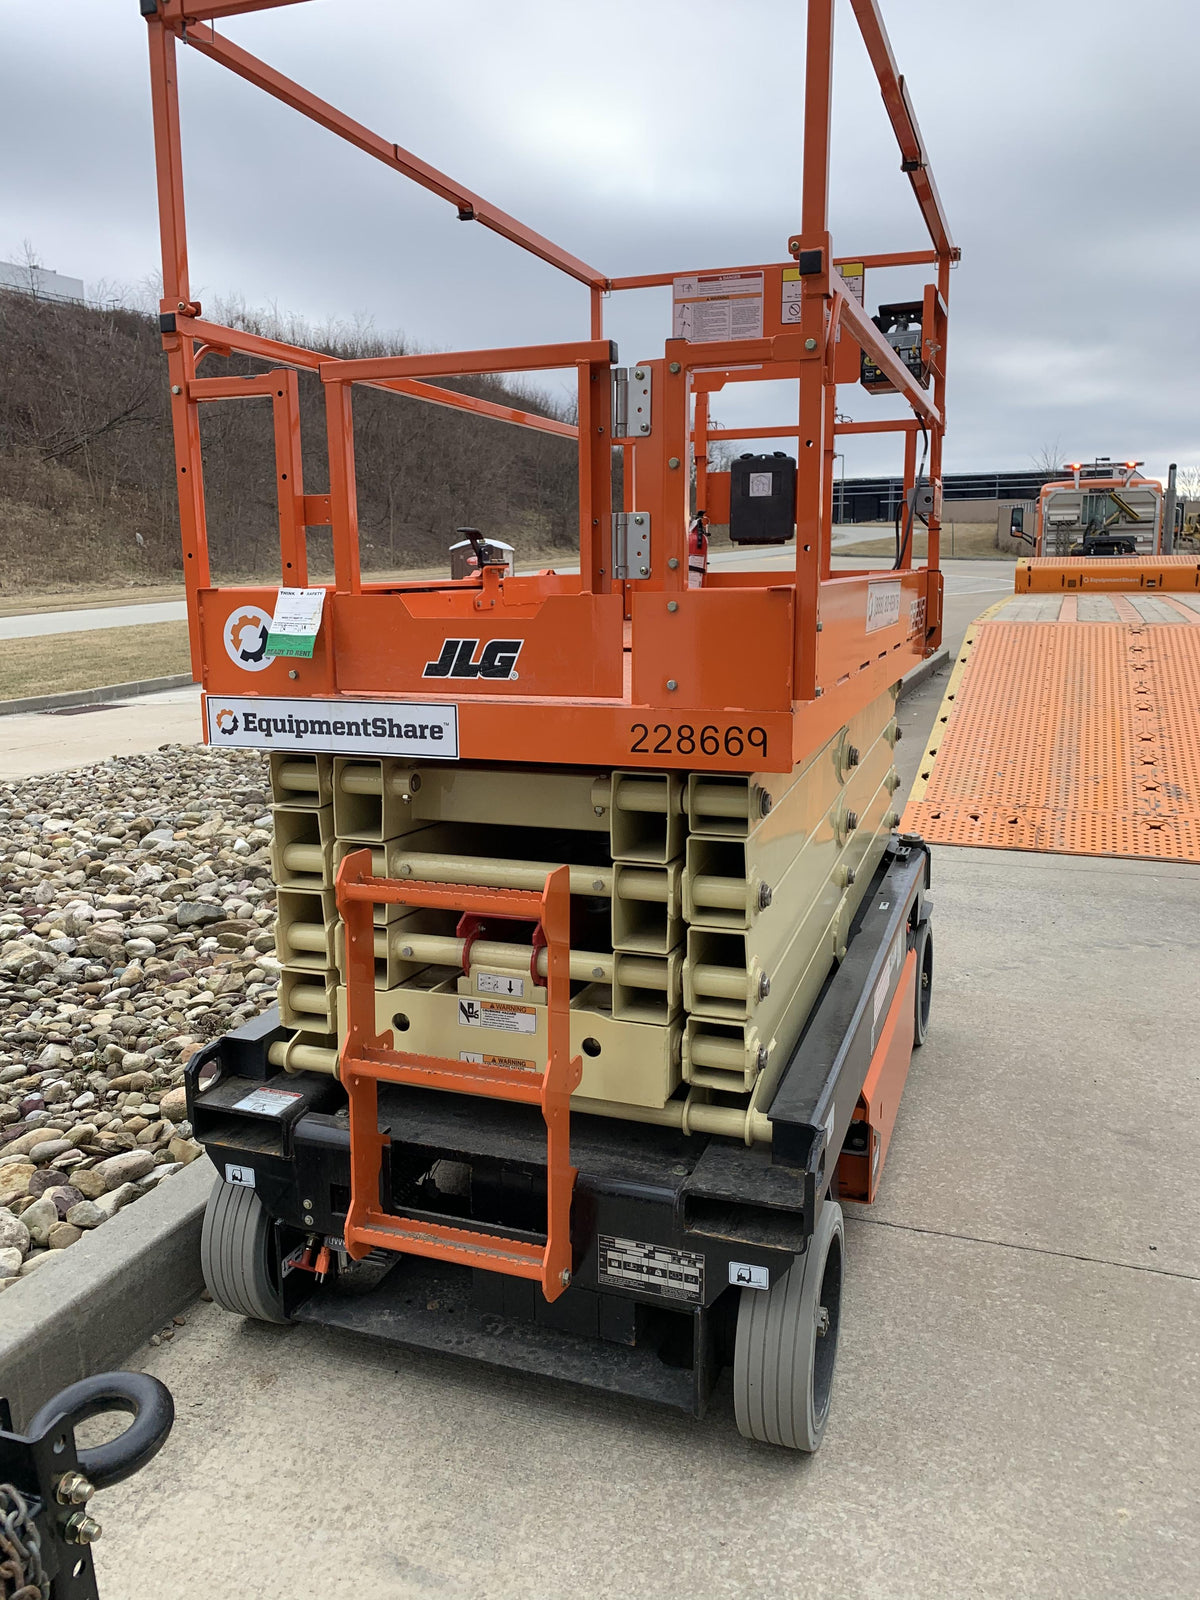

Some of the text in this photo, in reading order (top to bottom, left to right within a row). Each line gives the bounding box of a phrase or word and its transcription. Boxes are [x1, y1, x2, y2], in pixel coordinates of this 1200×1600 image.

[421, 638, 525, 680] JLG
[242, 712, 444, 741] EquipmentShare
[630, 723, 768, 758] 228669
[496, 1003, 527, 1014] WARNING
[498, 1058, 527, 1067] WARNING
